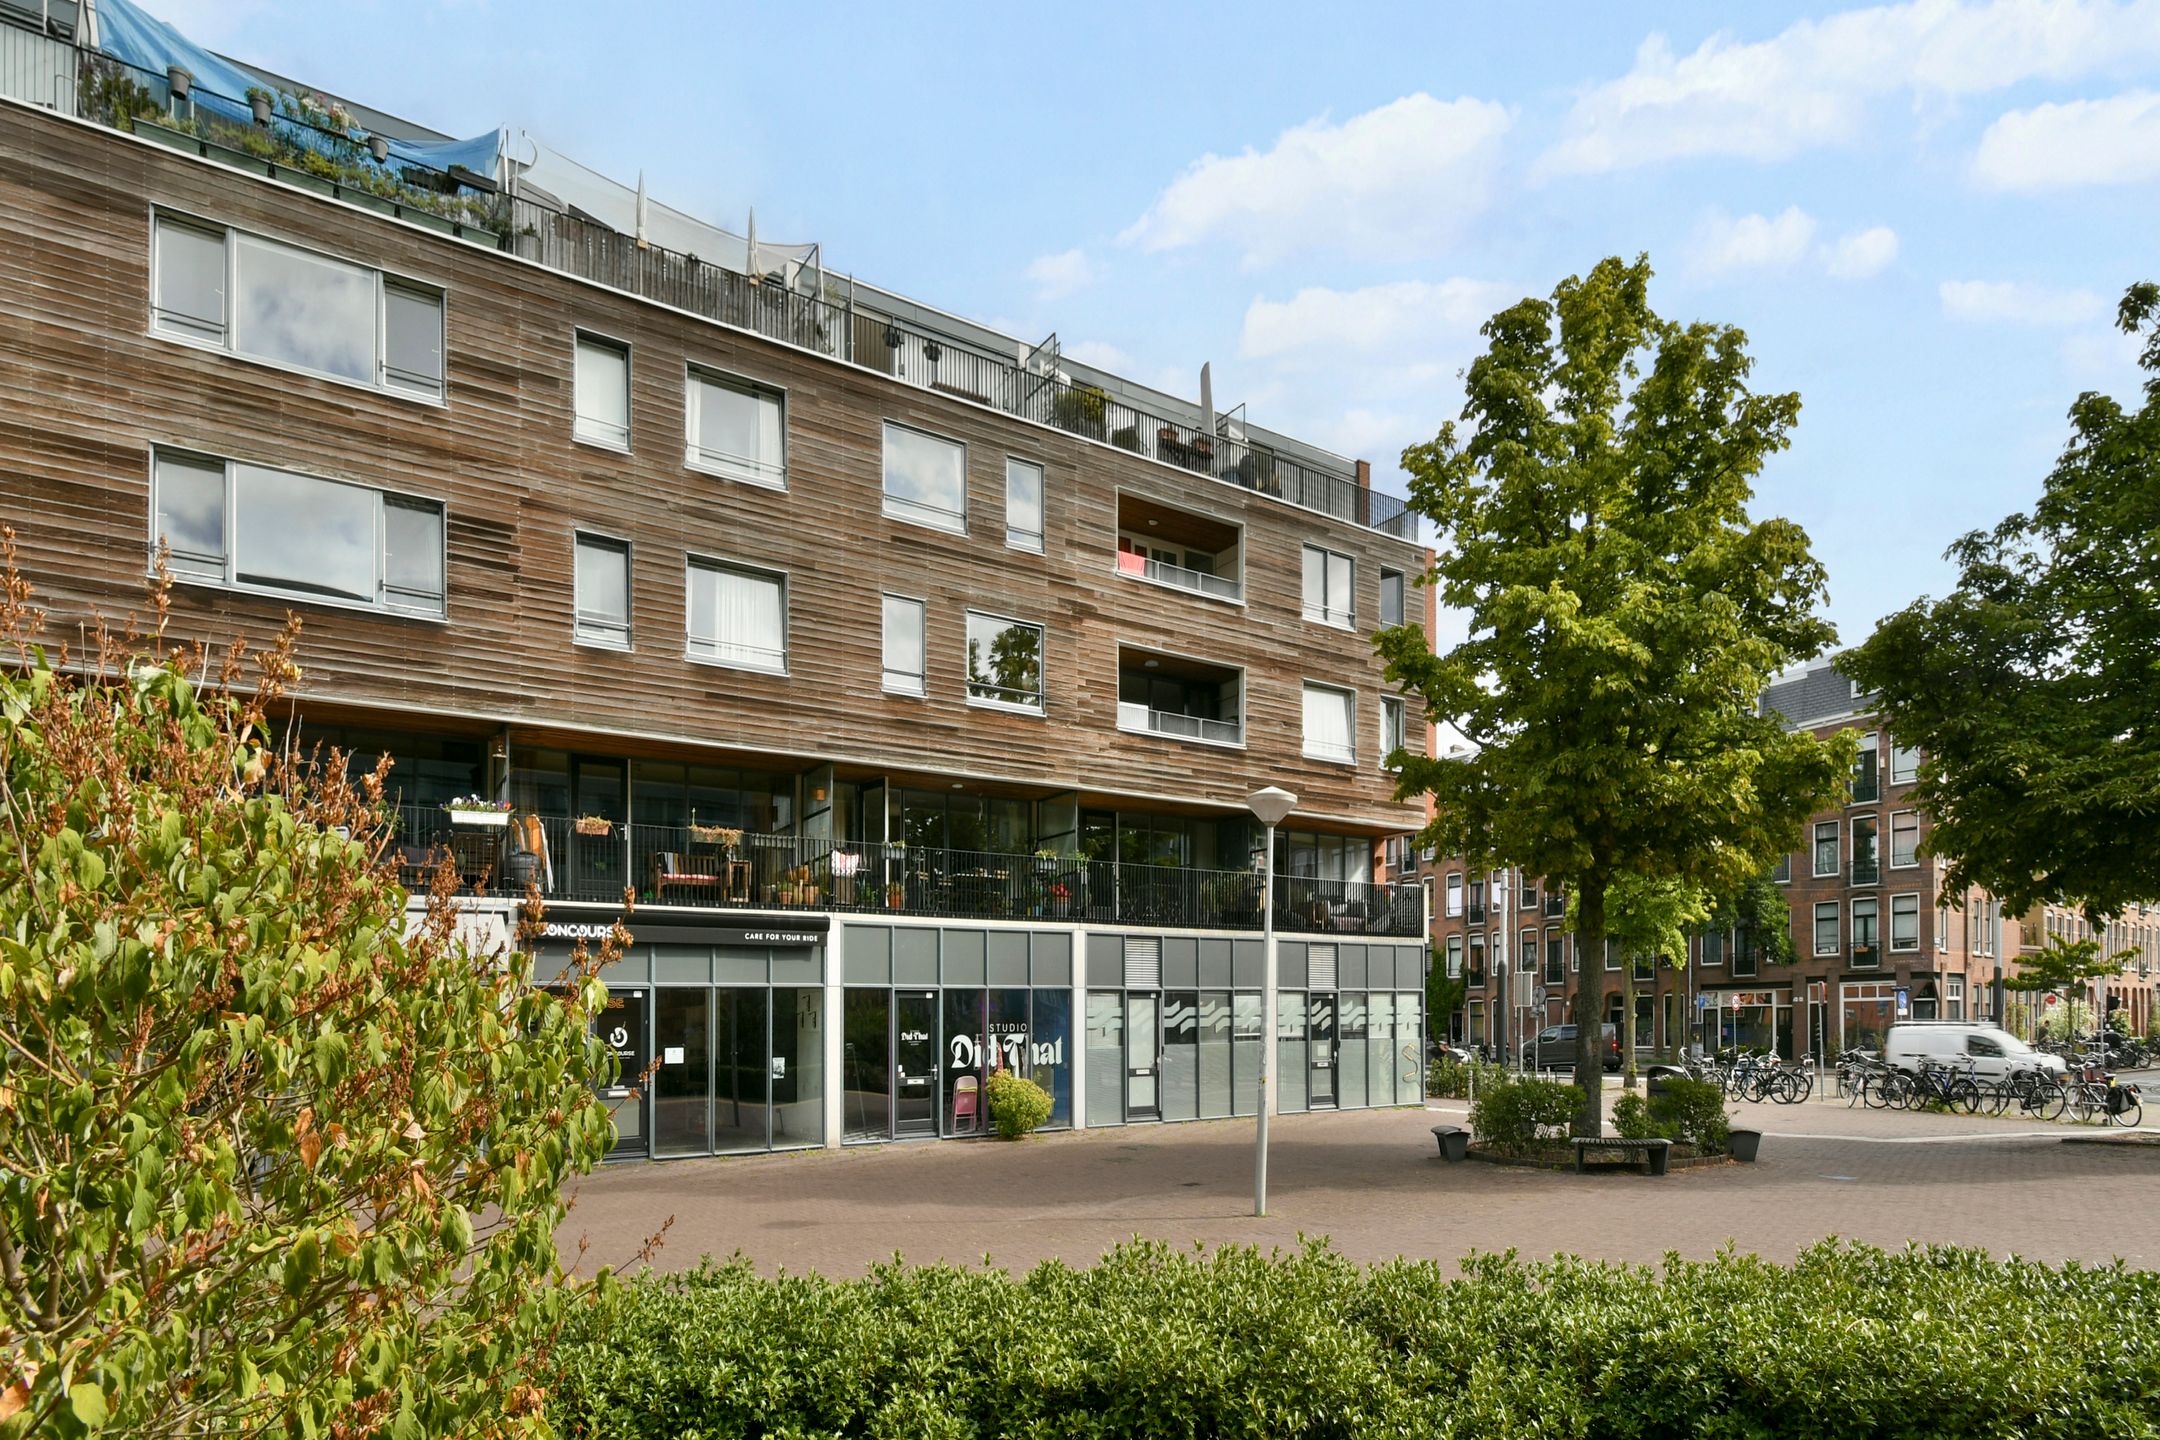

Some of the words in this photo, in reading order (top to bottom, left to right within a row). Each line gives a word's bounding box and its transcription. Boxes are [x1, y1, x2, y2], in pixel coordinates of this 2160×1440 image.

[540, 923, 614, 938] ONCOURS
[765, 933, 780, 941] FOR
[989, 1023, 1028, 1033] STUDIO
[951, 1034, 998, 1069] Did
